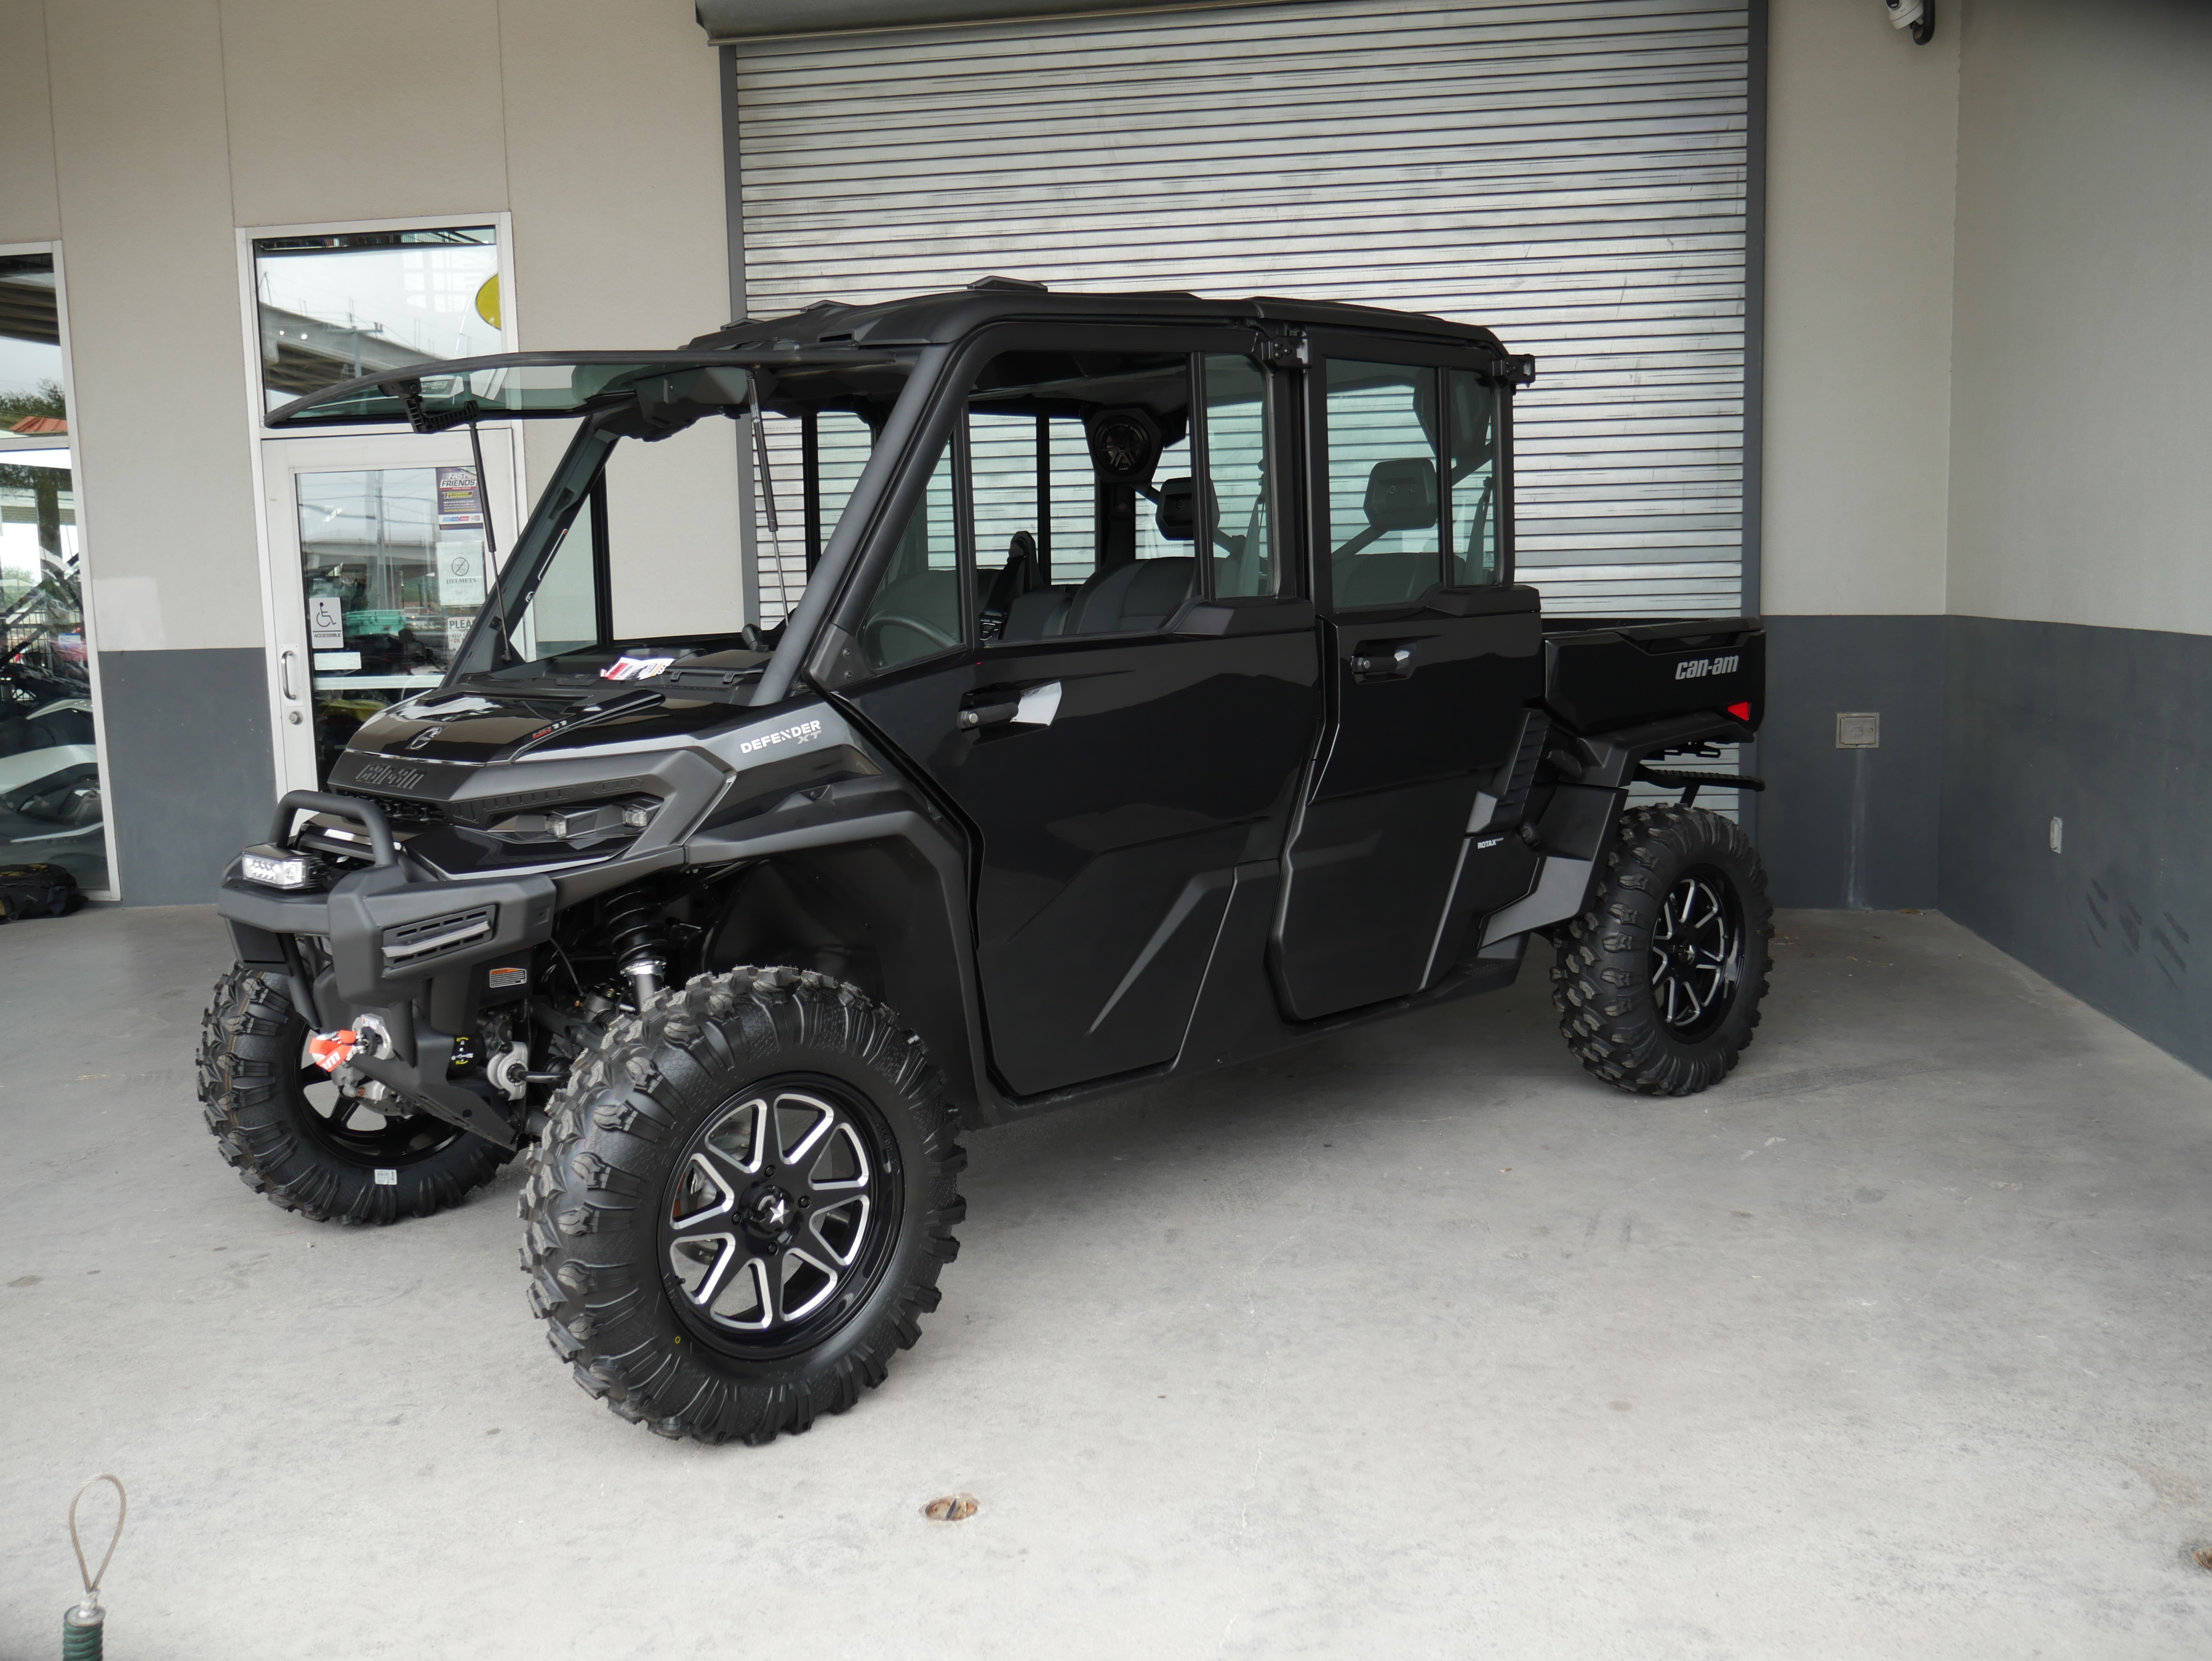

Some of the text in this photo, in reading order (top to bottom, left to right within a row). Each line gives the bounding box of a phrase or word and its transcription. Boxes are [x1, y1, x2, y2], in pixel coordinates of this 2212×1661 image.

[449, 620, 474, 629] PLEA
[740, 720, 821, 753] DEFENDER
[797, 730, 821, 744] XT
[1477, 839, 1496, 849] ROTAX
